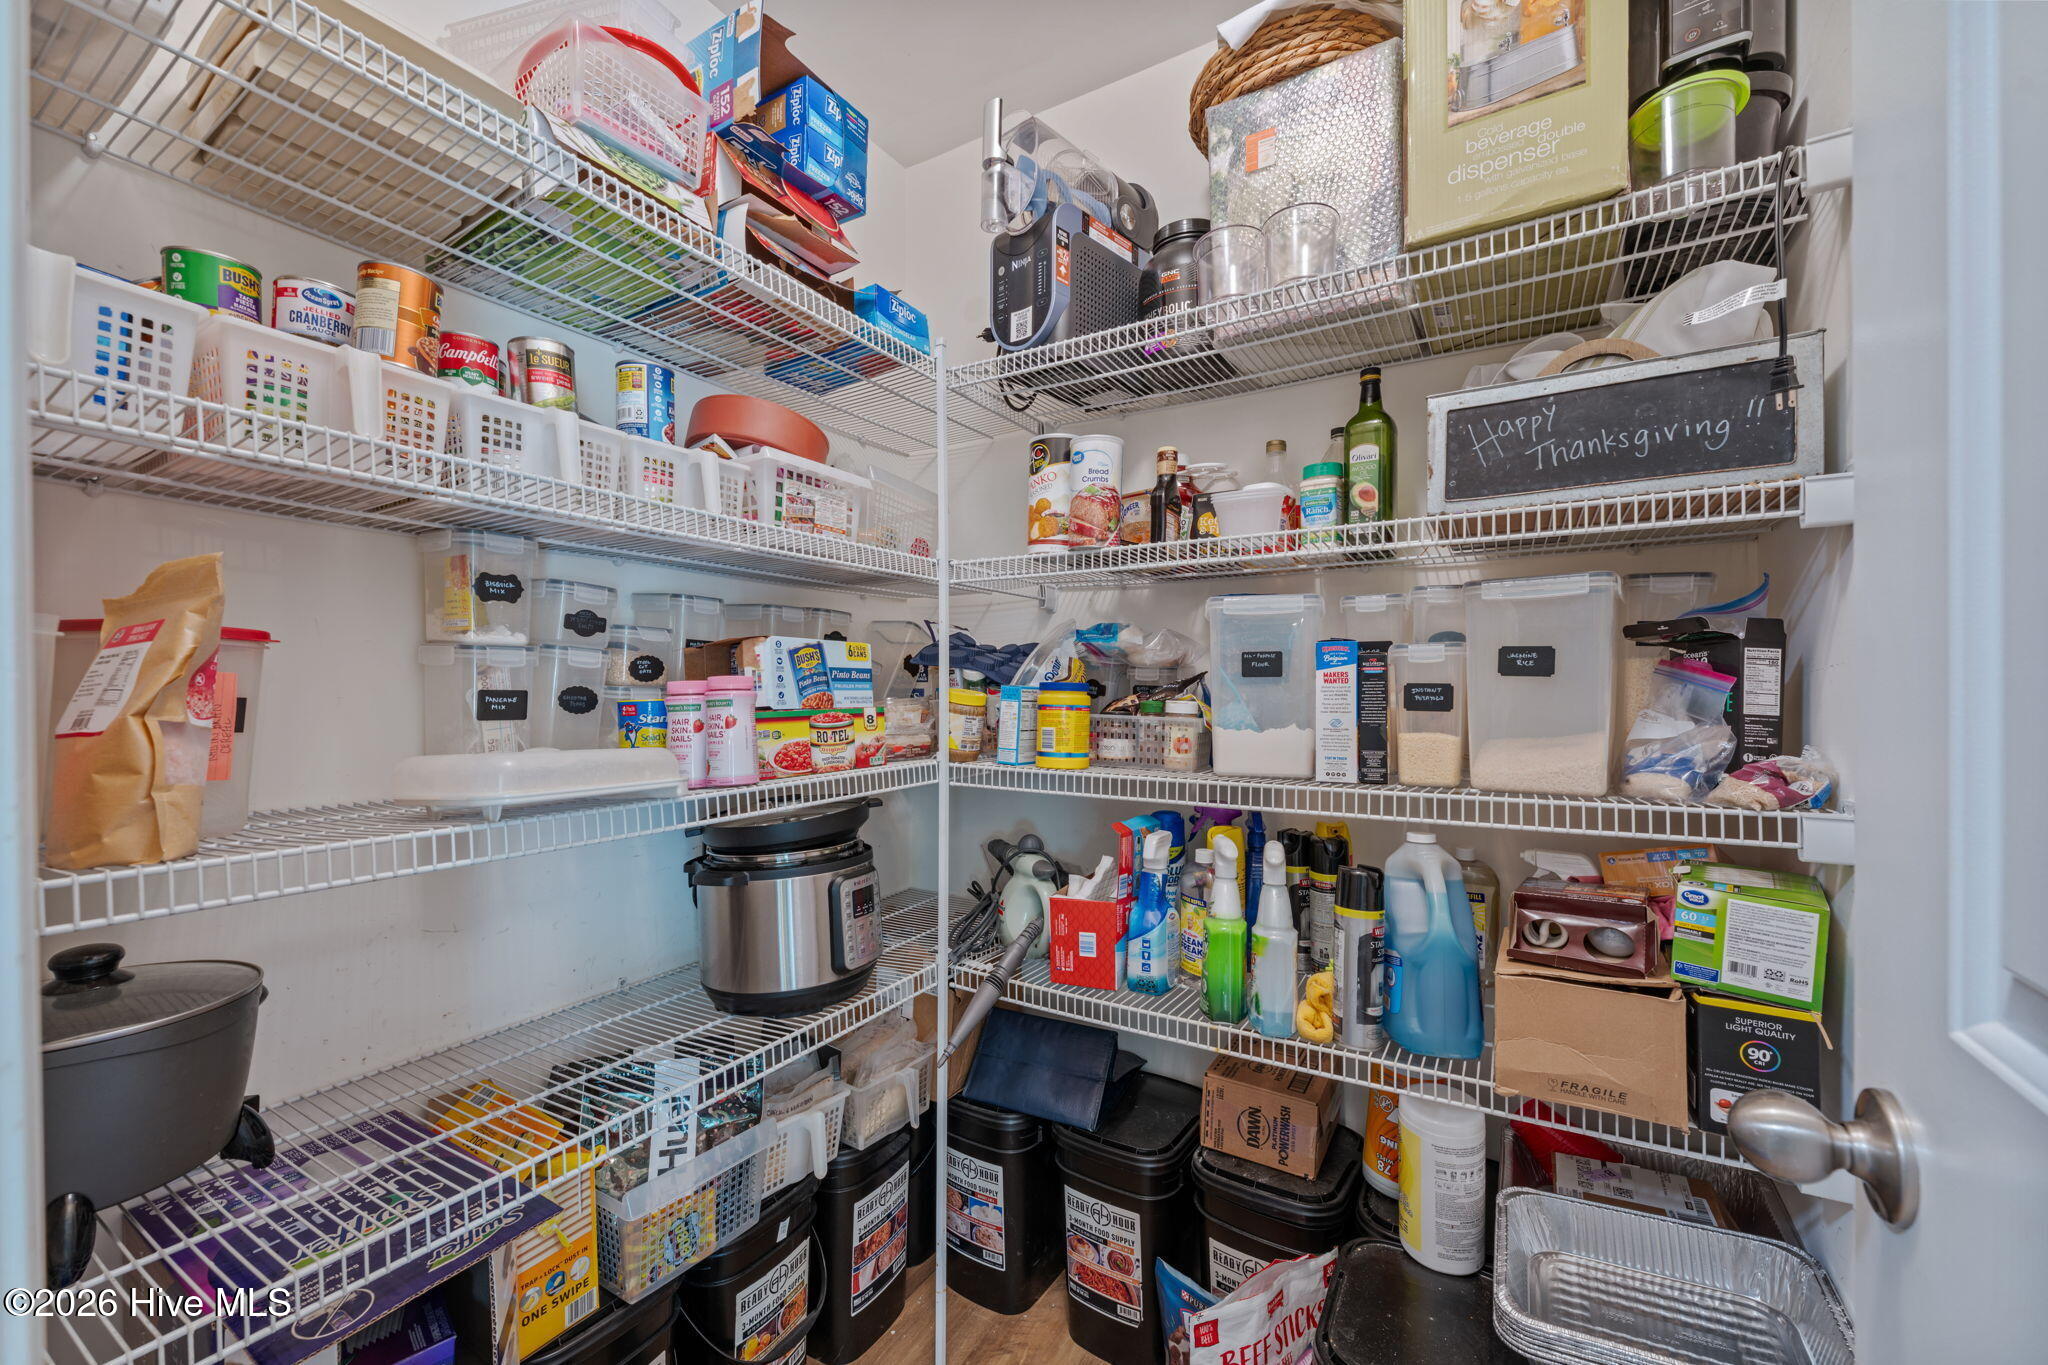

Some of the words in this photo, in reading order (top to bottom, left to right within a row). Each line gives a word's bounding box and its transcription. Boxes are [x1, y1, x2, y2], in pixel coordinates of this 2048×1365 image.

[709, 27, 725, 80] Ziploc
[719, 84, 732, 118] 152
[790, 84, 804, 126] Ziploc
[1465, 117, 1553, 154] beverage
[1537, 122, 1586, 144] double
[1447, 139, 1561, 185] dispenser
[823, 198, 850, 216] 152
[1161, 268, 1180, 277] GNC
[223, 268, 260, 297] BUSH'S
[303, 305, 341, 320] JELLIED
[891, 298, 917, 324] Ziploc
[289, 309, 351, 338] CRANBERRY
[306, 325, 336, 338] SAUCE
[439, 343, 501, 371] Campbell's
[541, 353, 570, 372] SUEUR
[1467, 402, 1557, 468] Happy
[1523, 417, 1731, 472] Thanksgiving
[1352, 453, 1377, 462] Olivari
[1352, 463, 1377, 472] AVOCADO
[489, 587, 506, 595] MIX
[796, 651, 821, 667] BUSH'S
[848, 645, 853, 657] 6
[1516, 659, 1535, 667] RICE
[831, 670, 850, 679] Pinto
[851, 671, 871, 680] Beans
[638, 713, 667, 724] Star
[866, 714, 874, 724] 8
[1684, 891, 1705, 901] Great
[1681, 912, 1697, 922] 60
[1181, 932, 1203, 948] CLEAN
[1181, 942, 1204, 957] FREAK
[1789, 977, 1809, 986] RoHS
[1725, 1022, 1752, 1034] LIGHT
[1754, 1027, 1797, 1041] QUALITY
[1734, 1016, 1783, 1031] SUPERIOR
[1560, 1080, 1628, 1100] FRAGILE
[1560, 1088, 1586, 1097] HANDLE
[1588, 1093, 1607, 1102] WITH
[1247, 1106, 1262, 1149] DAWN
[1271, 1115, 1279, 1150] PLATINUM
[1278, 1105, 1291, 1167] POWERWASH
[979, 1168, 999, 1183] HOUR
[1376, 1160, 1392, 1176] 78
[964, 1179, 977, 1191] FOOD
[978, 1185, 999, 1198] SUPPLY
[857, 1201, 878, 1221] READY
[880, 1203, 892, 1217] FOOD
[1068, 1196, 1090, 1214] READY
[1112, 1215, 1136, 1232] HOUR
[428, 1199, 526, 1270] Swiffer
[1068, 1214, 1094, 1233] 3-MONTH
[1094, 1225, 1110, 1239] FOOD
[1111, 1233, 1136, 1247] SUPPLY
[520, 1277, 539, 1291] TRAP
[543, 1263, 561, 1278] LOCK
[564, 1251, 580, 1264] DUST
[581, 1245, 588, 1254] IN
[1213, 1250, 1241, 1270] READY
[741, 1285, 769, 1314] READY
[789, 1248, 807, 1274] HOUR
[1214, 1270, 1241, 1288] 3-MONT
[521, 1304, 548, 1328] ONE
[551, 1277, 591, 1310] SWIPE
[742, 1305, 771, 1331] 3-MONTH
[772, 1289, 787, 1308] FOOD
[787, 1270, 806, 1293] SUPPLY
[1200, 1334, 1213, 1345] BEEF
[1220, 1333, 1271, 1365] BEEF
